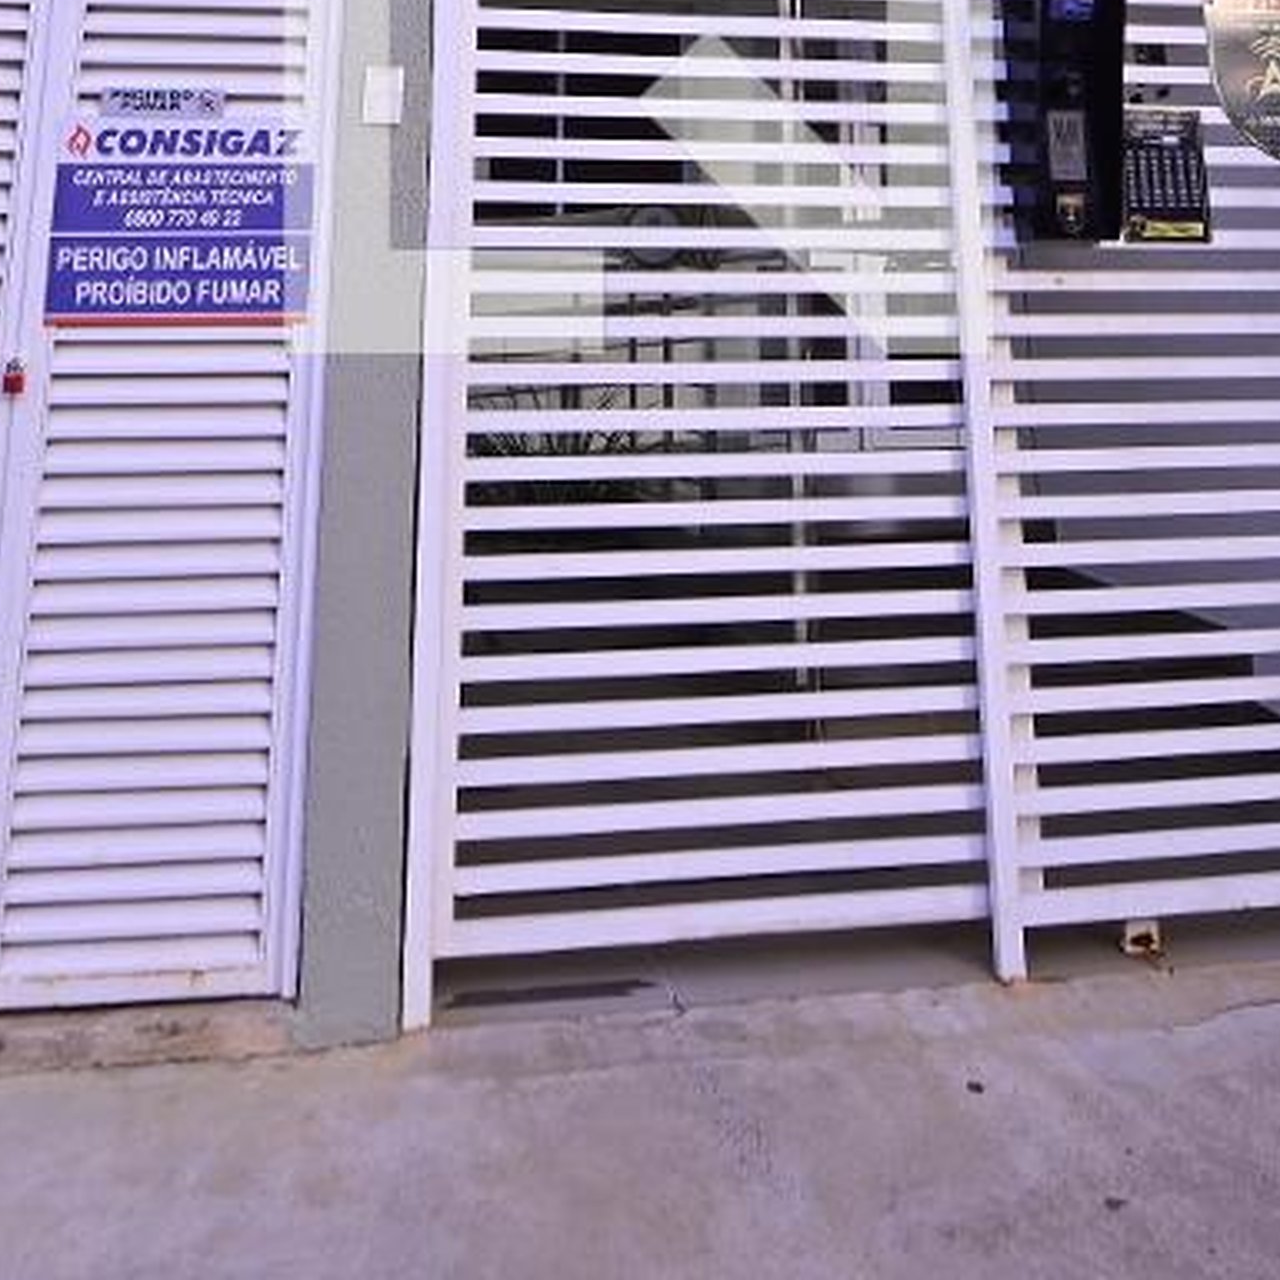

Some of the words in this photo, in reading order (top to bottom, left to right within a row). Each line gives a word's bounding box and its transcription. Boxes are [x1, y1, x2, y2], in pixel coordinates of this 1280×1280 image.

[95, 128, 304, 158] CONSIGAZ
[73, 169, 143, 186] CENTRAL
[146, 170, 167, 185] DE
[56, 245, 149, 271] PERIGO
[154, 239, 300, 270] INFLAMÁVEL
[196, 279, 283, 305] FUMAR
